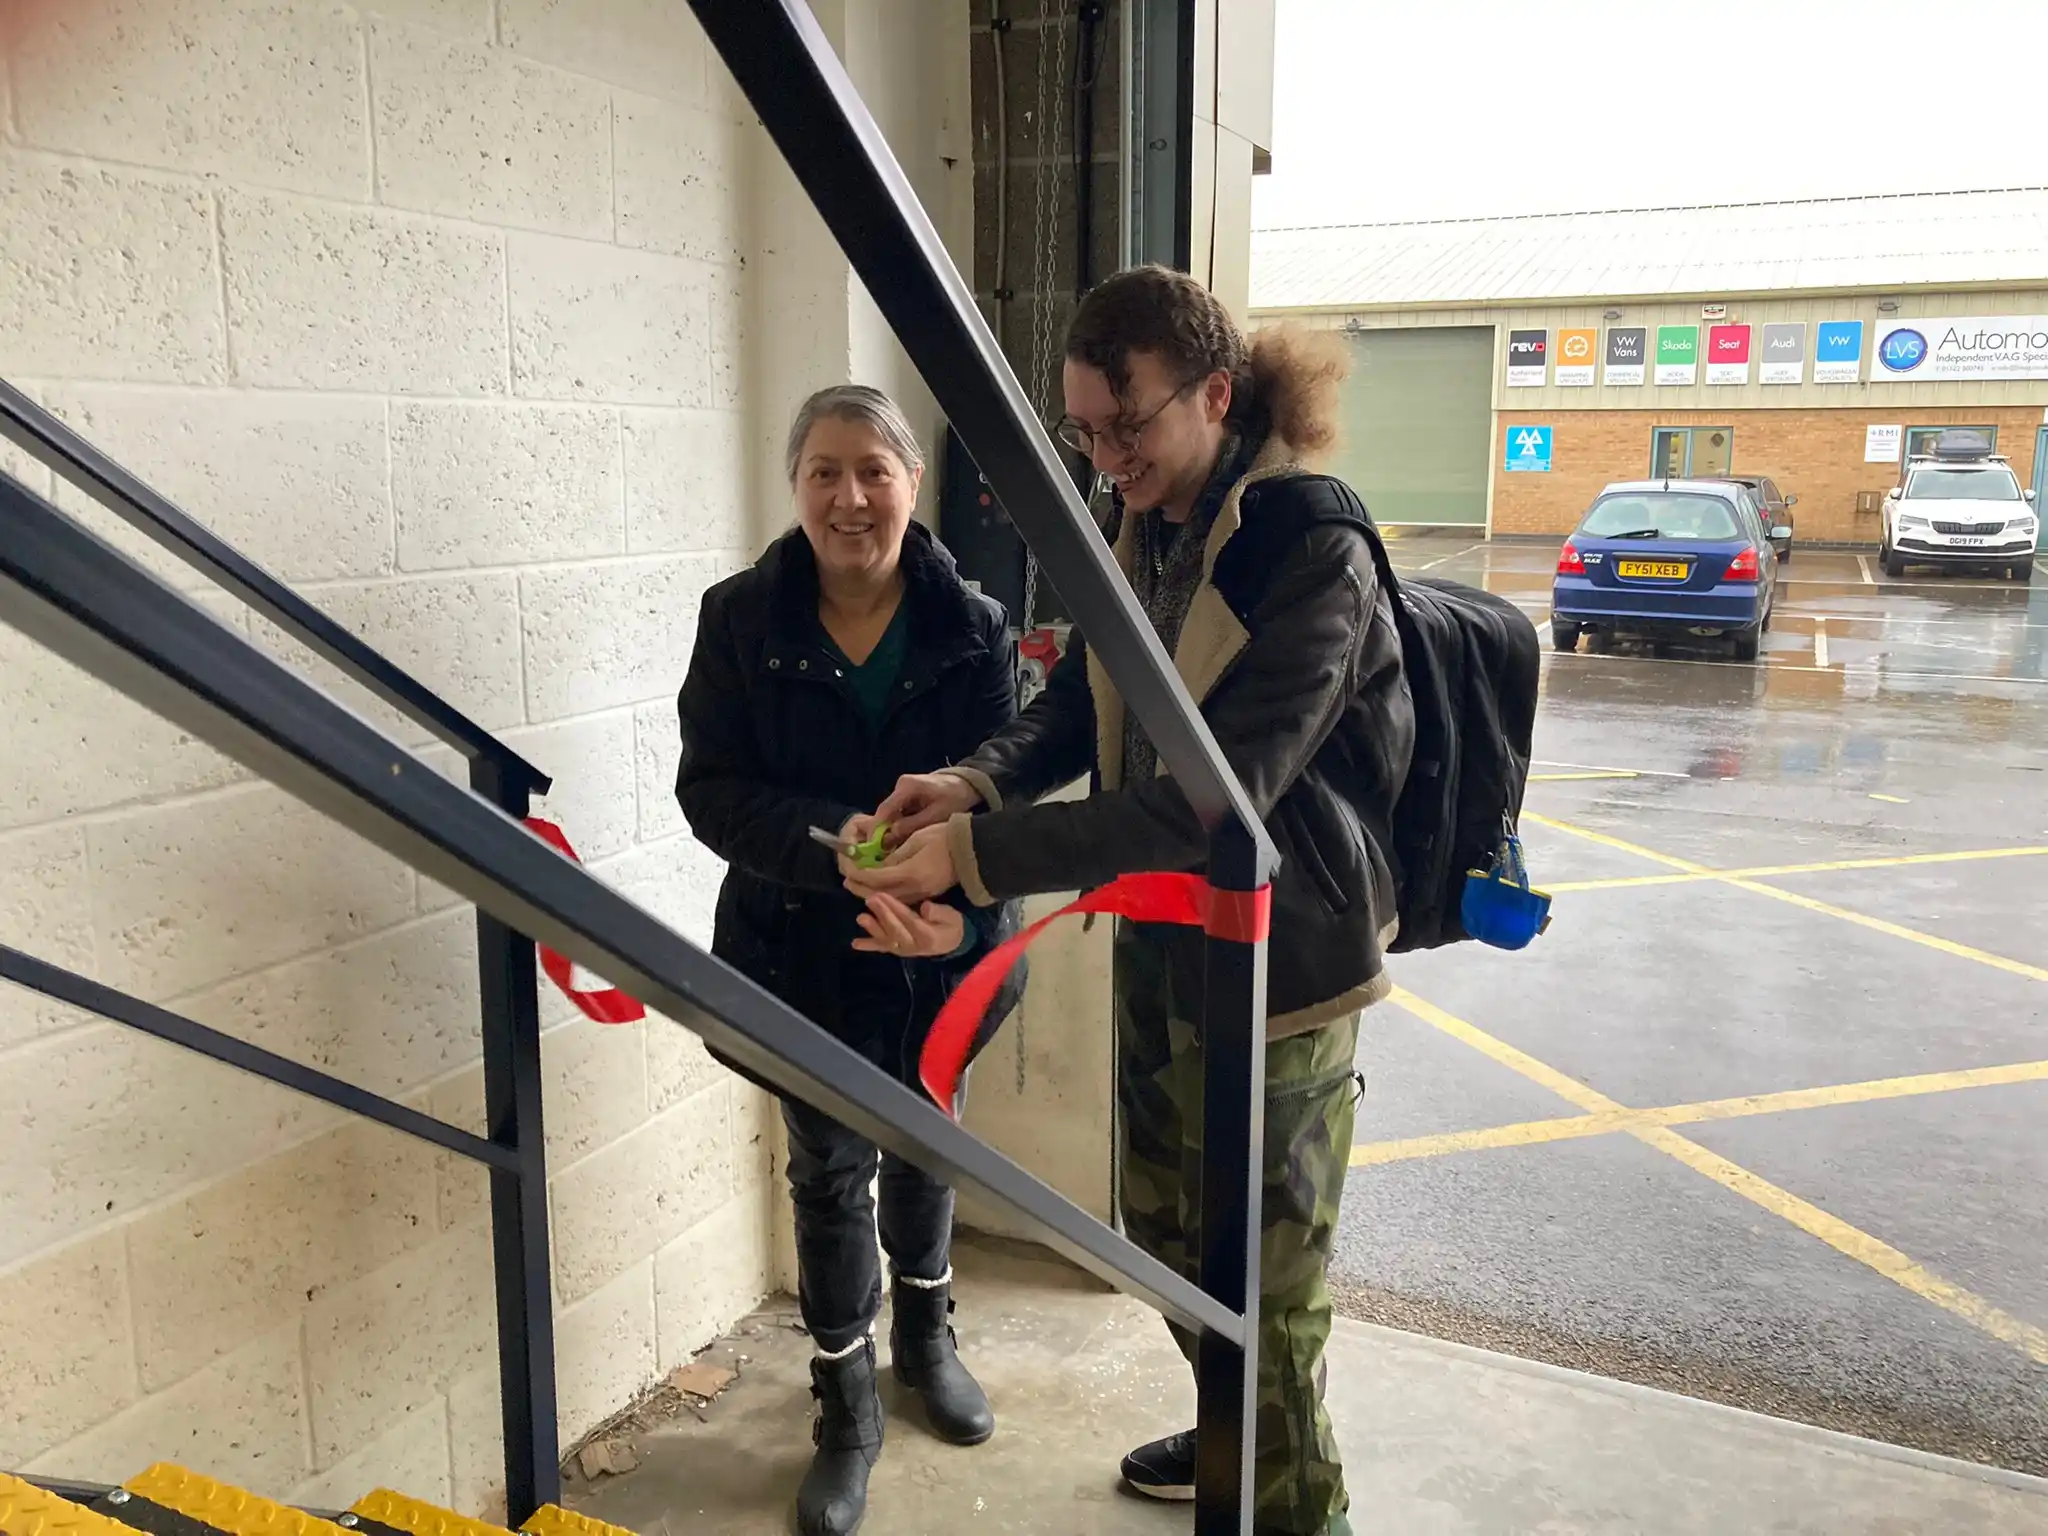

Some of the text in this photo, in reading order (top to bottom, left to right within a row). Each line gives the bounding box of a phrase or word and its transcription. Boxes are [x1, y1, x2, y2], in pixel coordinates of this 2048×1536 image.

[1617, 336, 1638, 346] VW
[1661, 339, 1692, 351] Skoda
[1717, 339, 1741, 350] Seat
[1770, 336, 1796, 348] Audi
[1828, 335, 1851, 346] VW
[1614, 346, 1638, 357] Vans
[1886, 341, 1920, 359] LVS
[1936, 352, 1993, 363] Independent
[1878, 429, 1898, 437] RMI
[1625, 563, 1680, 576] FY51 XEB
